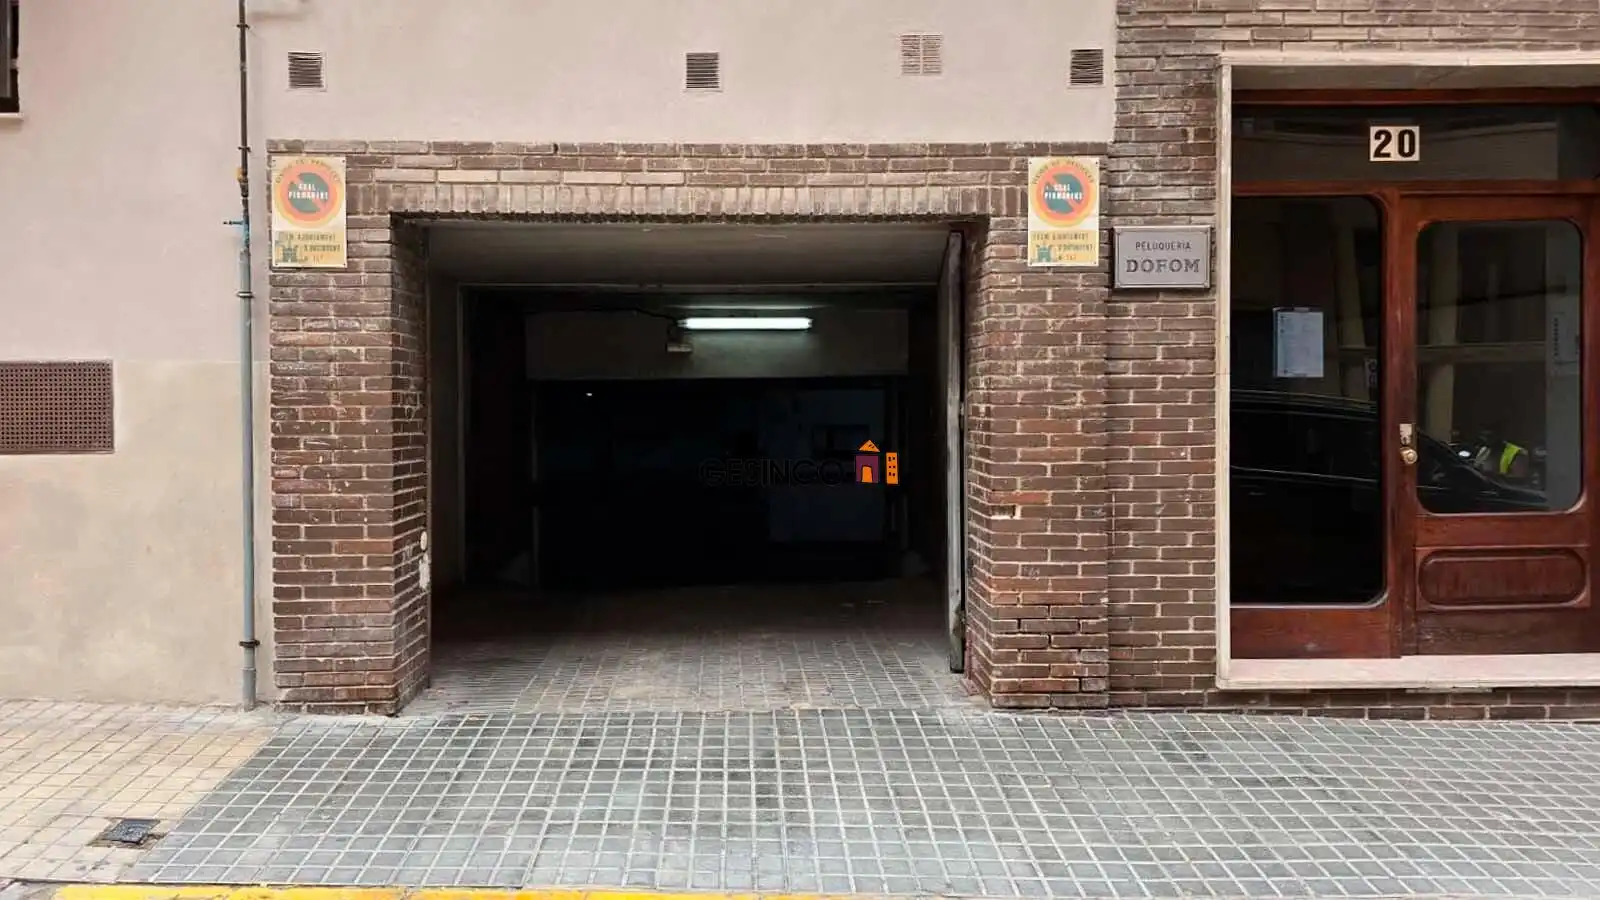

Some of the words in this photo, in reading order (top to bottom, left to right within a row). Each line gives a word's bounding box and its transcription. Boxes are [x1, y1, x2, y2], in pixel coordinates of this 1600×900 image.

[1373, 129, 1416, 158] 20
[1135, 241, 1192, 251] PELUQUERIA
[1126, 258, 1201, 273] DOFOM
